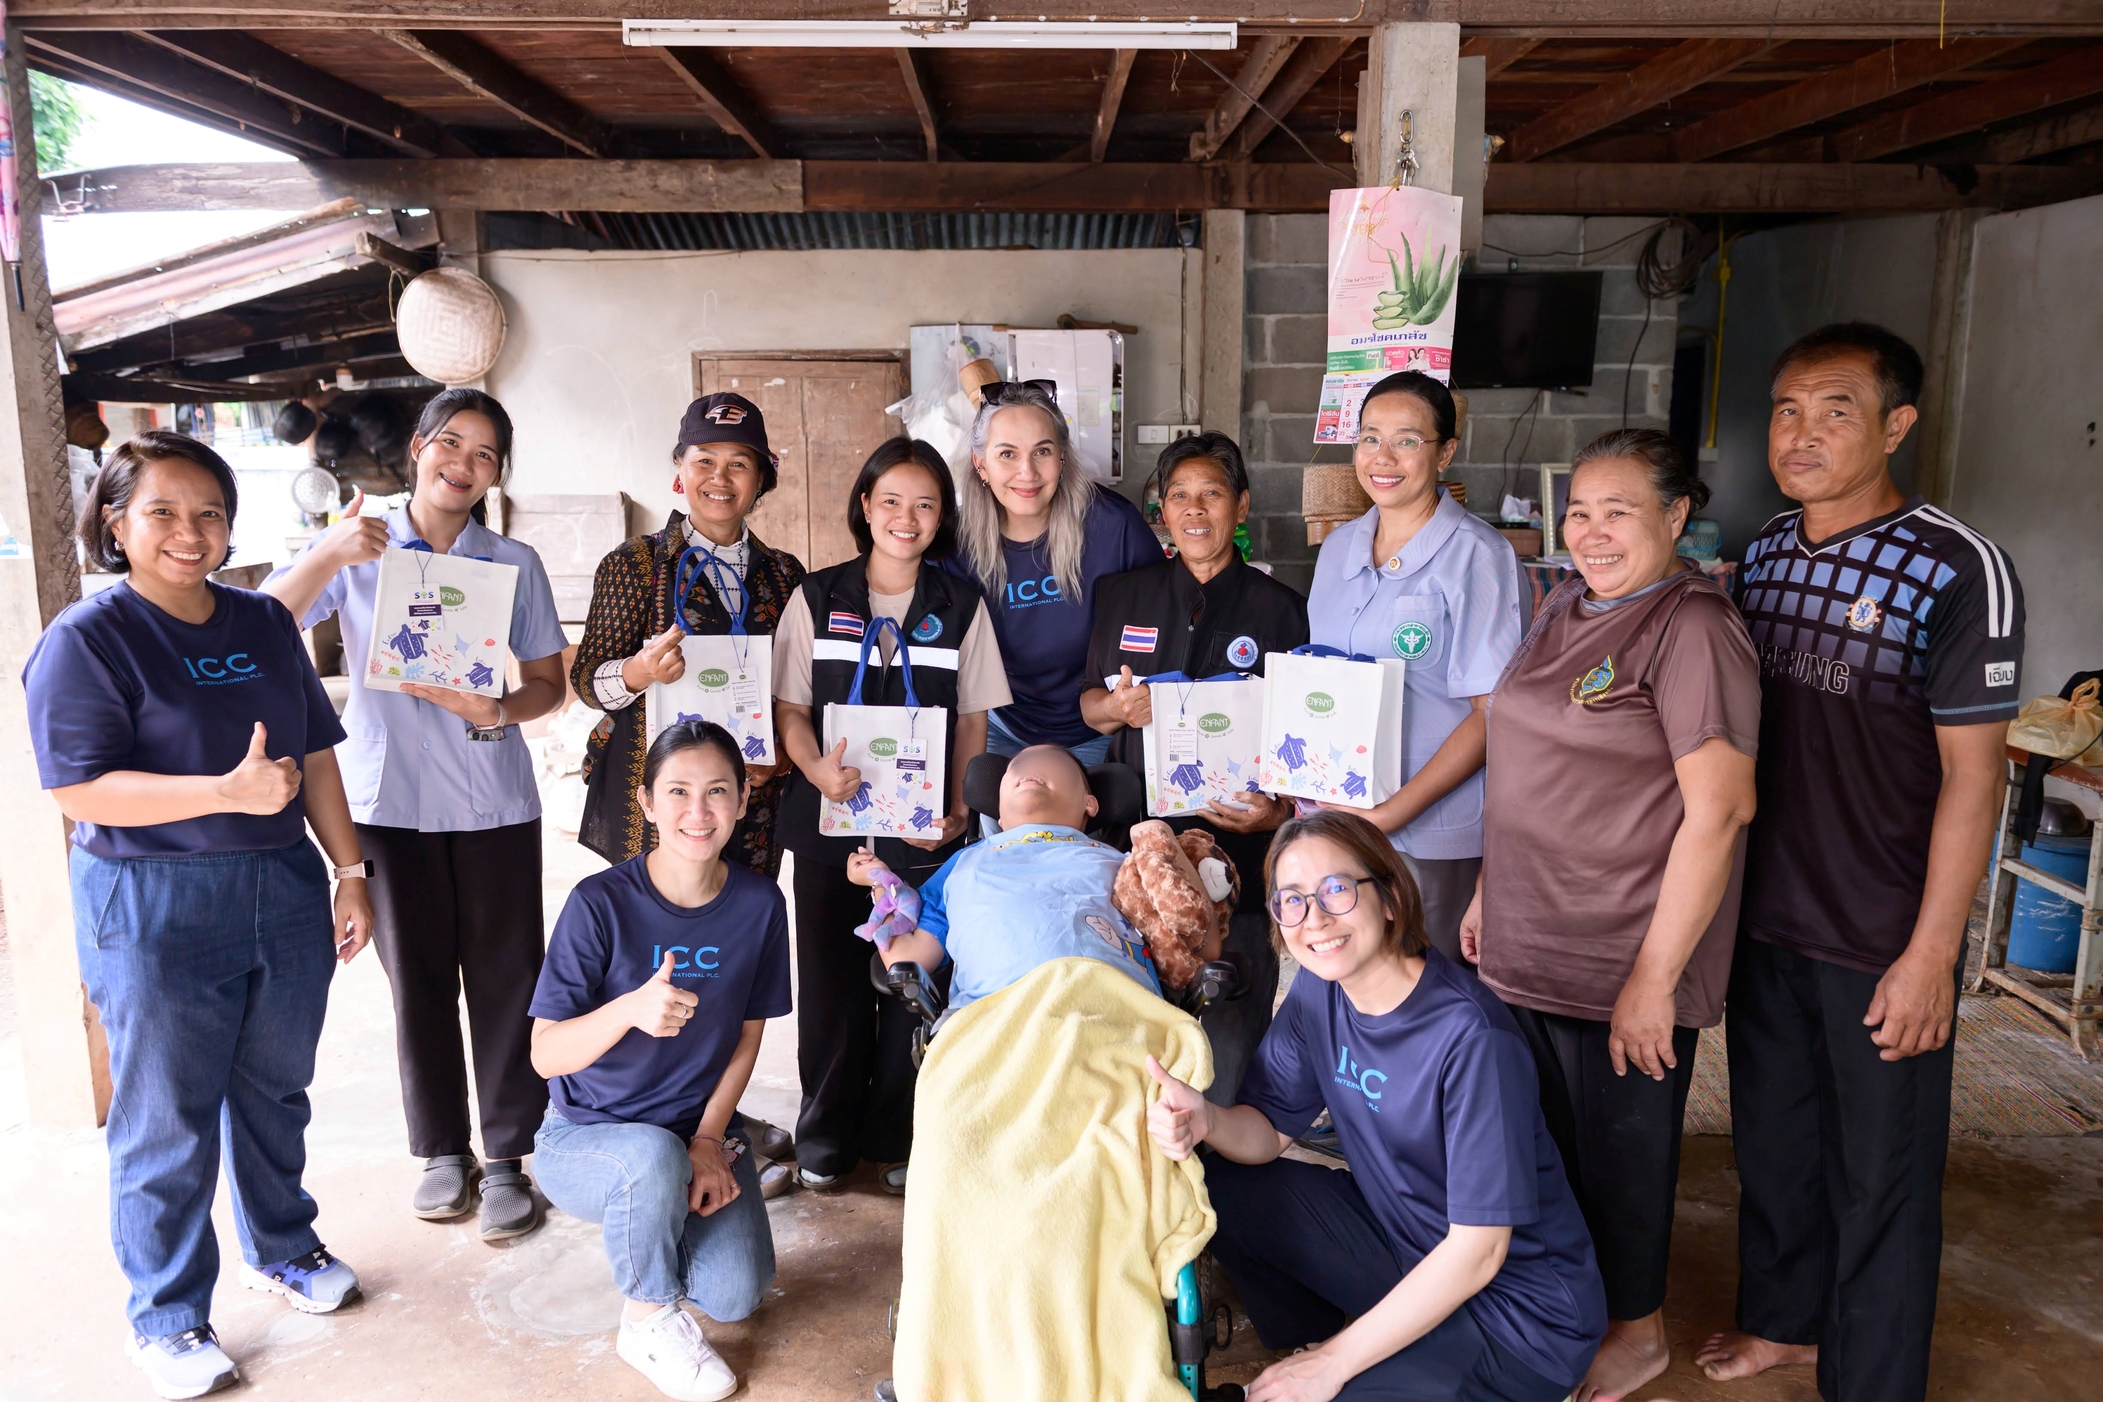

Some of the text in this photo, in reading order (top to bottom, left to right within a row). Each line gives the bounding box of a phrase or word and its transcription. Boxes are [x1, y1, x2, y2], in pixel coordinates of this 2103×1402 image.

[1346, 399, 1352, 407] 2
[1345, 410, 1350, 418] 9
[1006, 575, 1062, 603] ICC
[1009, 598, 1053, 610] INTERNATIONAL
[183, 653, 258, 678] ICC
[195, 675, 249, 686] INTERNATIONAL
[700, 673, 728, 683] ENFANT
[1307, 696, 1333, 709] ENFANT
[1200, 718, 1228, 727] ENFANT
[652, 944, 720, 970] ICC
